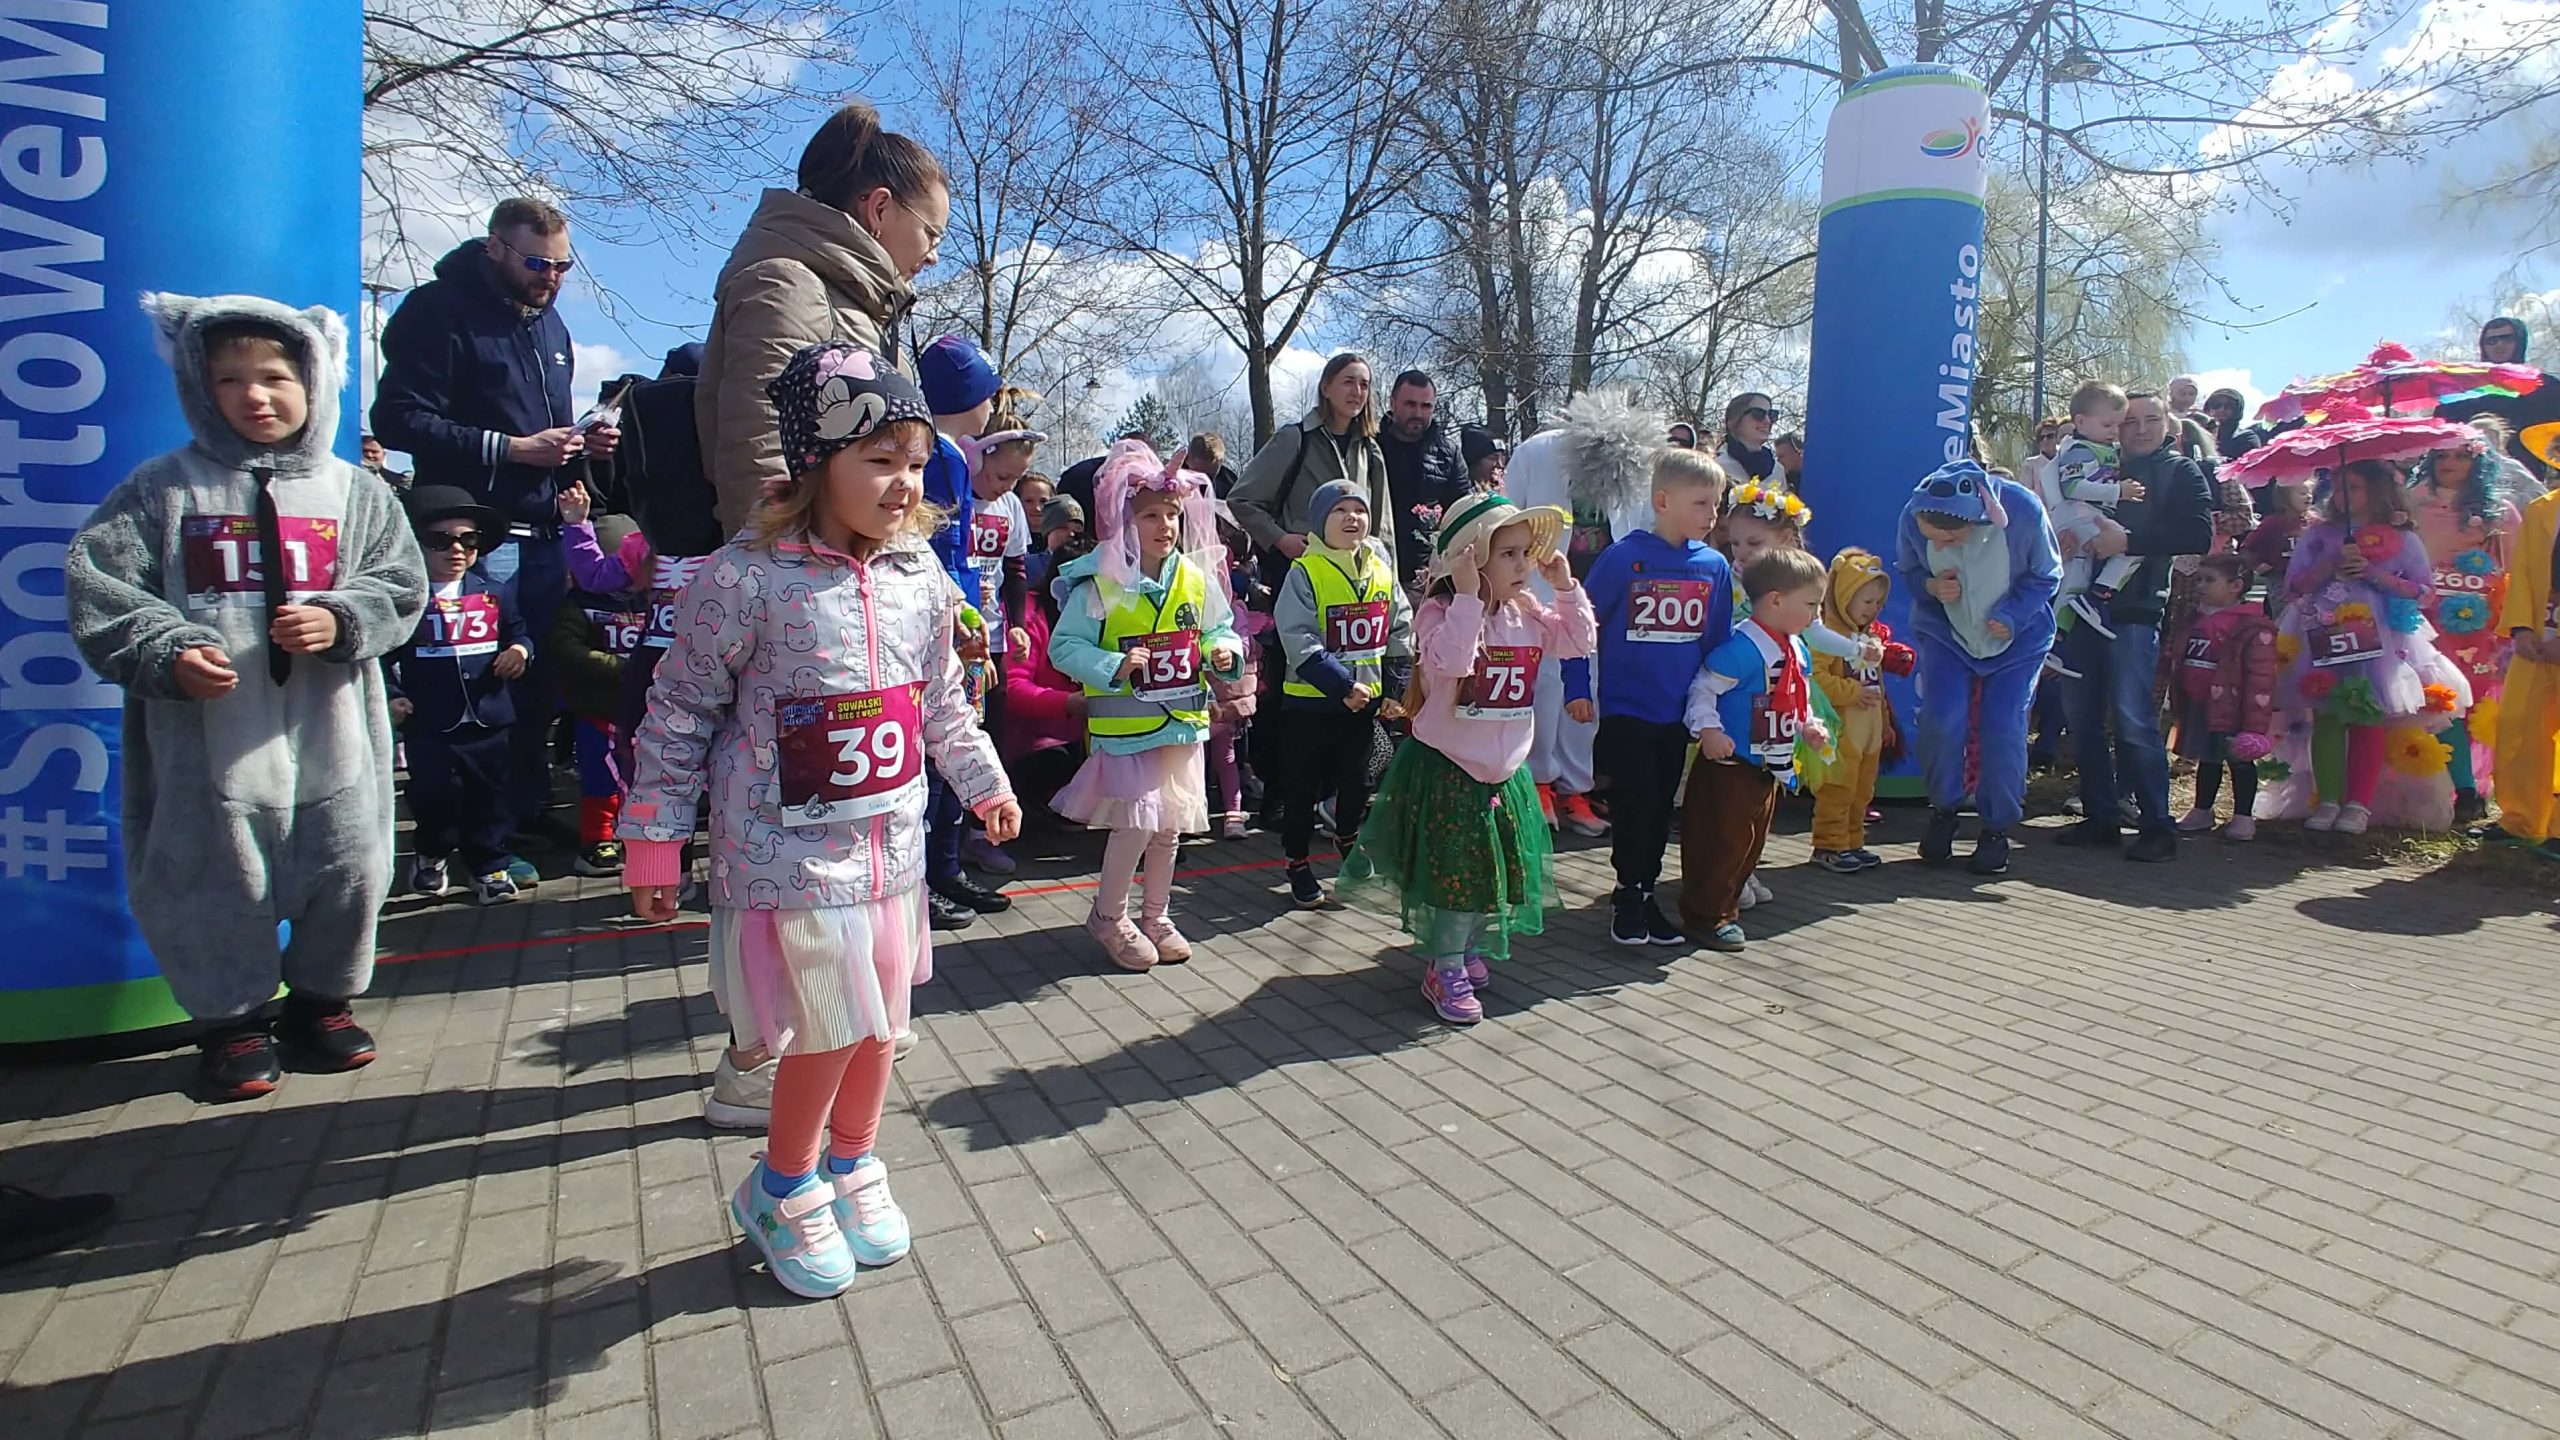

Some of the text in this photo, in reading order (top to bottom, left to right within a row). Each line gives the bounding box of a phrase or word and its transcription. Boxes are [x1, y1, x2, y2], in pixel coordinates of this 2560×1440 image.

[426, 610, 488, 640] 173
[1634, 596, 1703, 627] 200
[1336, 615, 1384, 646] 107
[2329, 632, 2359, 653] 51
[2187, 639, 2211, 657] 77
[1142, 648, 1192, 684] 133
[1485, 667, 1525, 701] 75
[837, 697, 883, 713] SUWALSKI
[827, 720, 905, 787] 39
